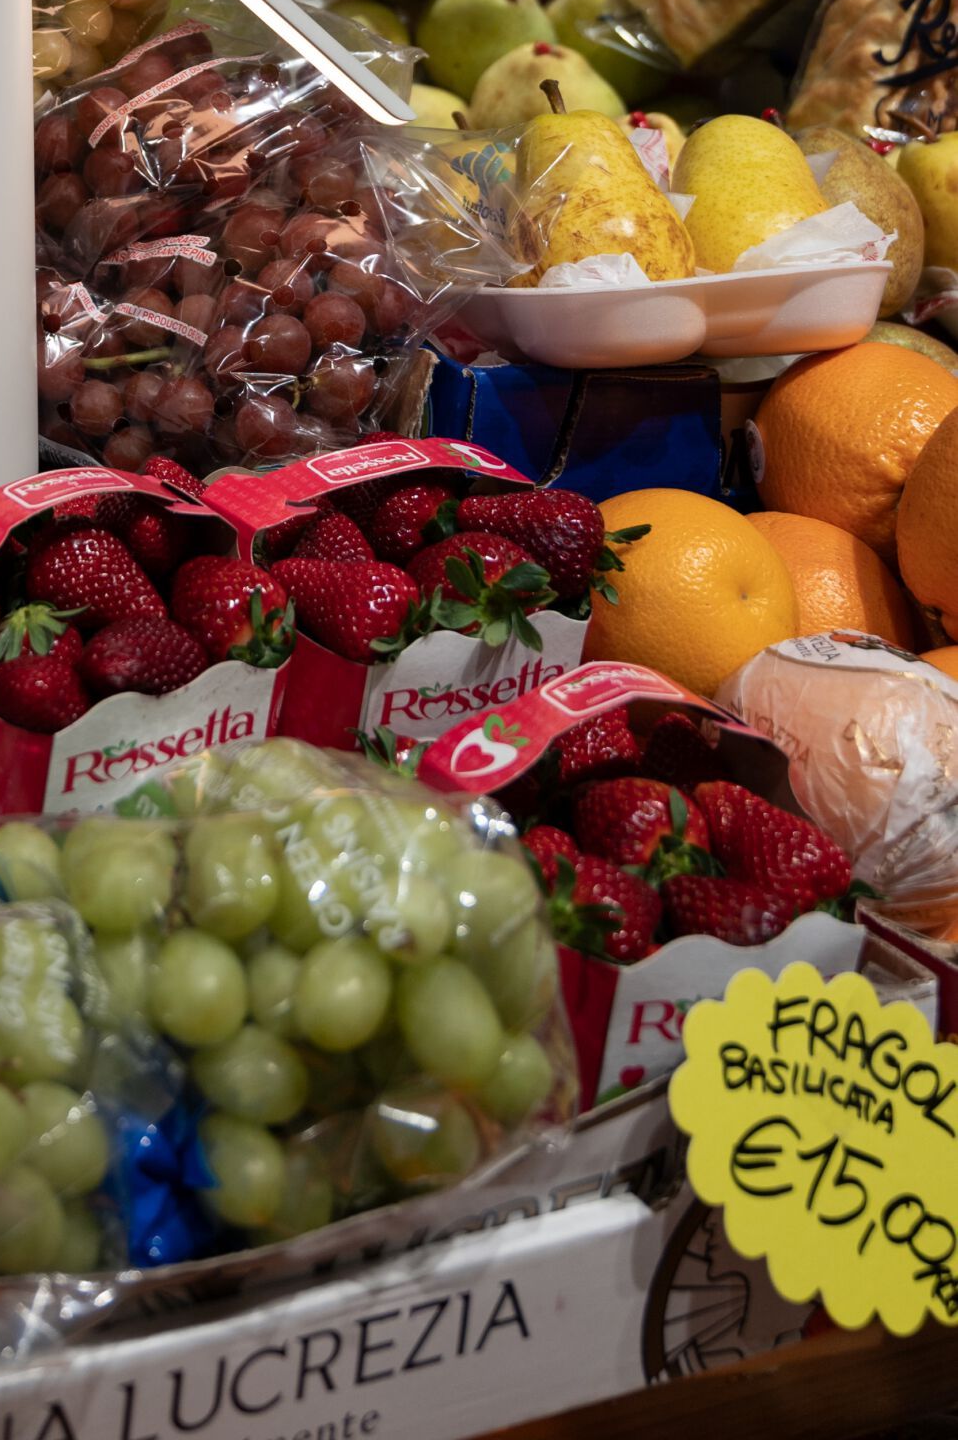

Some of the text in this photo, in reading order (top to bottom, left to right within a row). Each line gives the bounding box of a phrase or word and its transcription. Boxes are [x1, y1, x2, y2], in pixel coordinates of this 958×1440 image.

[129, 91, 153, 111] CHILE
[155, 69, 189, 92] PRODUIT
[178, 245, 215, 265] PEPINS
[141, 311, 188, 337] PRODUCTO
[381, 654, 569, 732] Rossetta
[60, 704, 258, 796] Rossetta
[720, 1041, 895, 1134] BASILICATA
[767, 996, 957, 1138] FRAGOL
[119, 1279, 531, 1440] LUCREZIA
